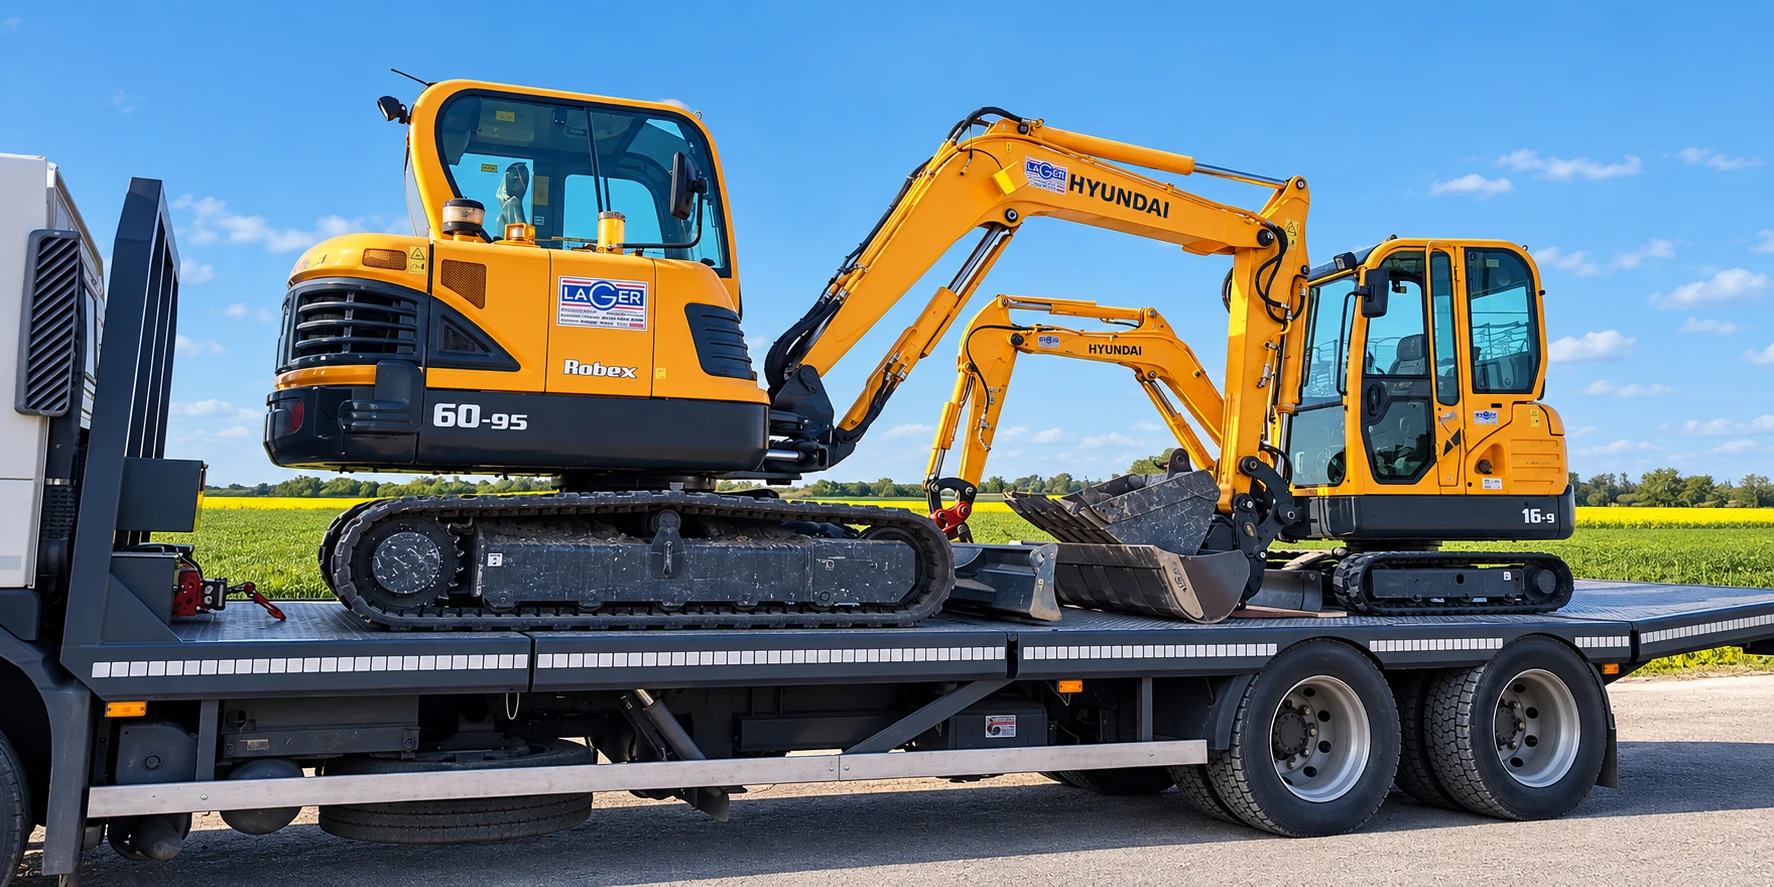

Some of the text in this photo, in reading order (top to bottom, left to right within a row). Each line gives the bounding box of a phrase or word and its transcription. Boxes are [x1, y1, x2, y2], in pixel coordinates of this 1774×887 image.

[1069, 174, 1170, 218] HYUNDAI
[564, 283, 641, 309] LAGER
[1088, 344, 1142, 356] HYUNDAI
[563, 359, 638, 379] Robex
[433, 403, 528, 430] 60-95
[1522, 508, 1555, 524] 16-9
